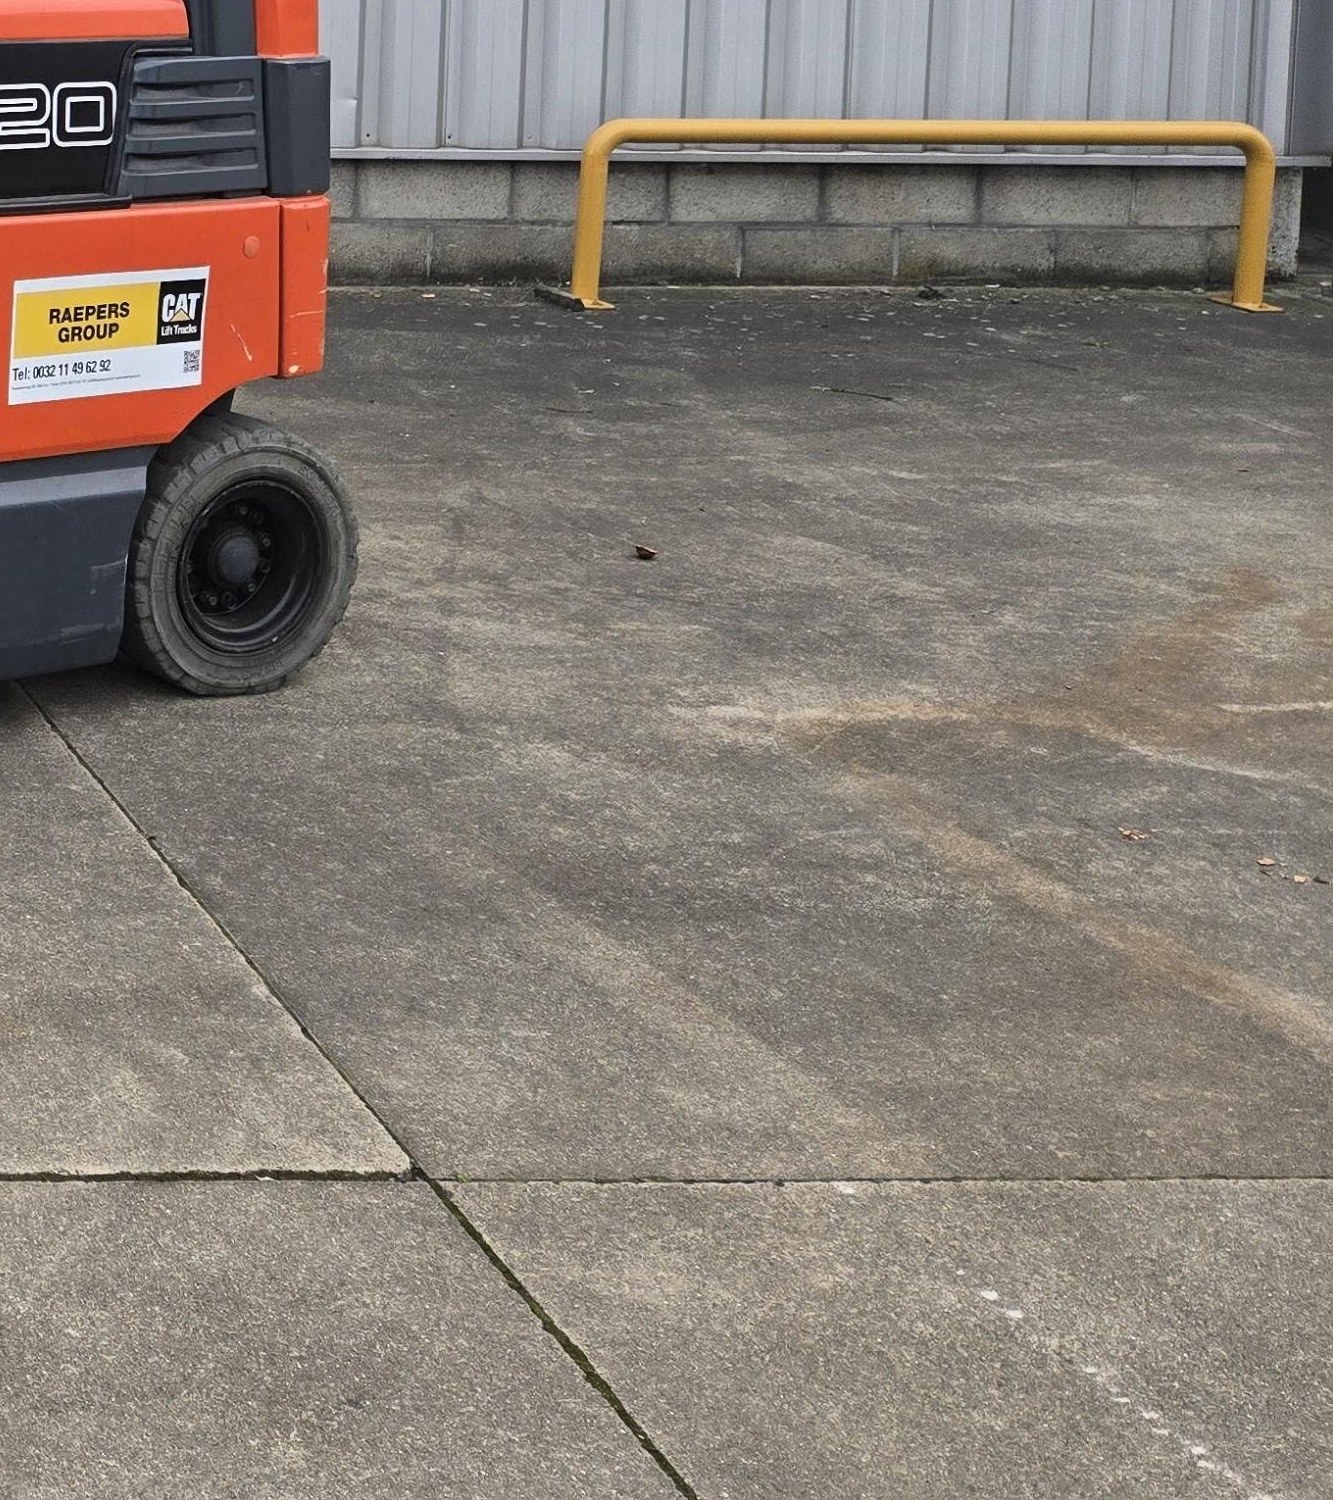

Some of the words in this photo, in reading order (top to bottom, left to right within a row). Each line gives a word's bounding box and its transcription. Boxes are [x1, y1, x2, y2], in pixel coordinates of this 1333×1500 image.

[49, 302, 130, 325] RAEPERS
[161, 292, 202, 323] CAT
[58, 322, 120, 344] GROUP
[161, 325, 173, 337] Lift
[174, 324, 198, 336] Trucks
[13, 367, 31, 381] Tel:
[33, 365, 56, 379] 0032
[58, 363, 69, 376] 11
[72, 362, 83, 375] 49
[85, 360, 97, 374] 62
[99, 359, 111, 372] 92
